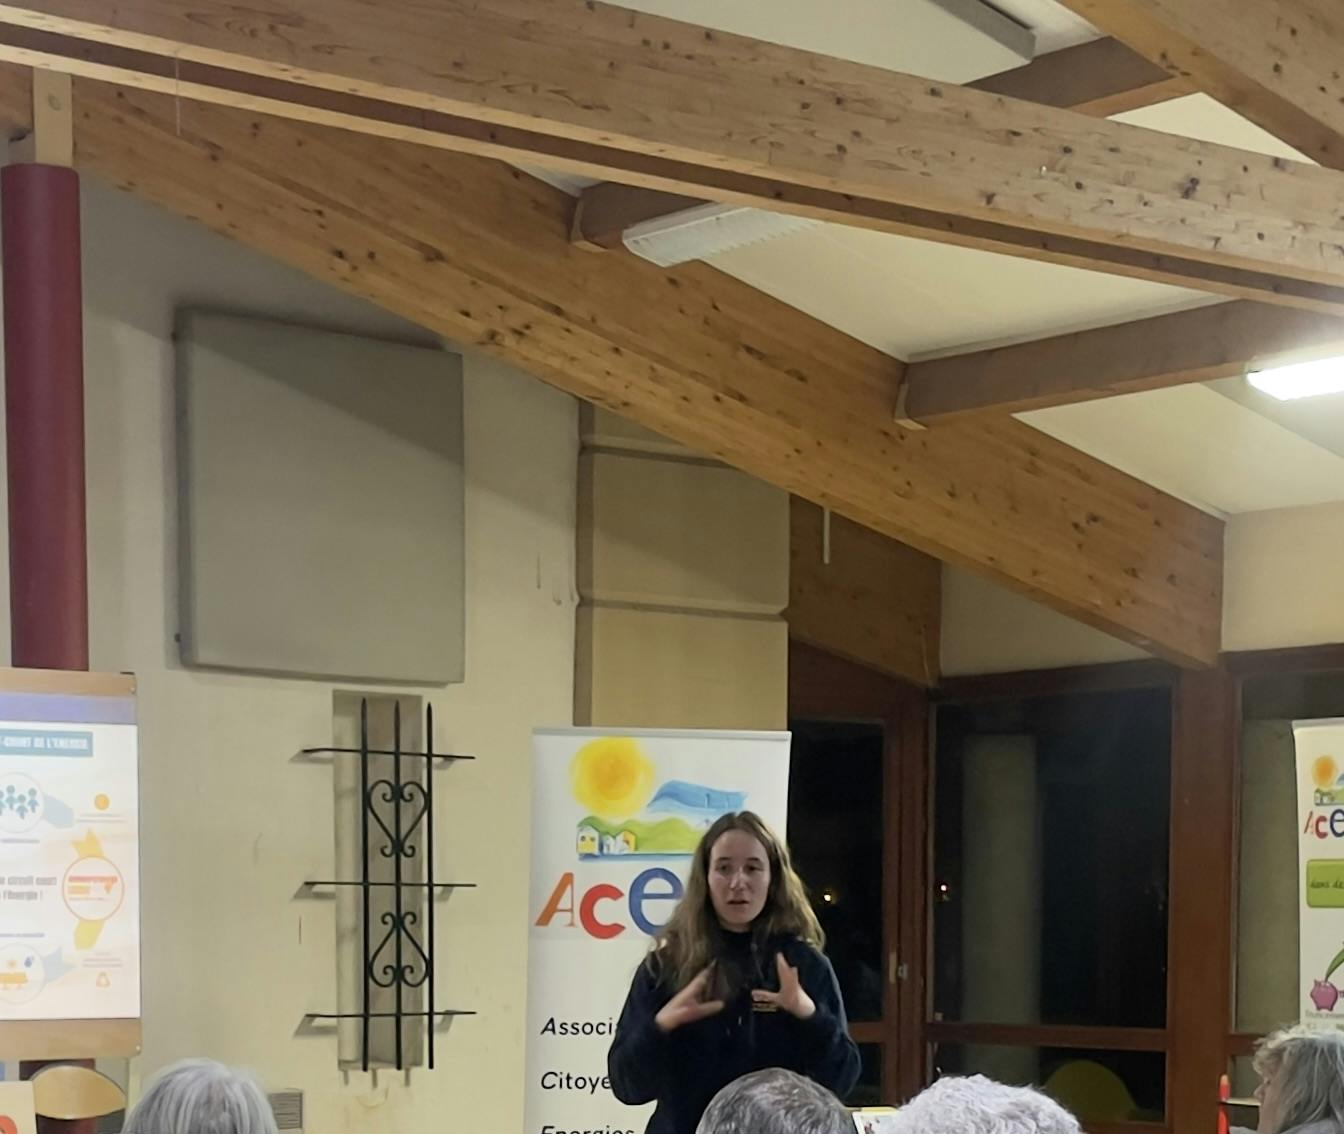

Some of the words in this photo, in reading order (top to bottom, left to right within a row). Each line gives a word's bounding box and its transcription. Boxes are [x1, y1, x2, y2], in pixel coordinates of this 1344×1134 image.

[535, 867, 684, 940] Ace
[541, 1017, 619, 1036] Associ
[541, 1071, 612, 1094] Citoye
